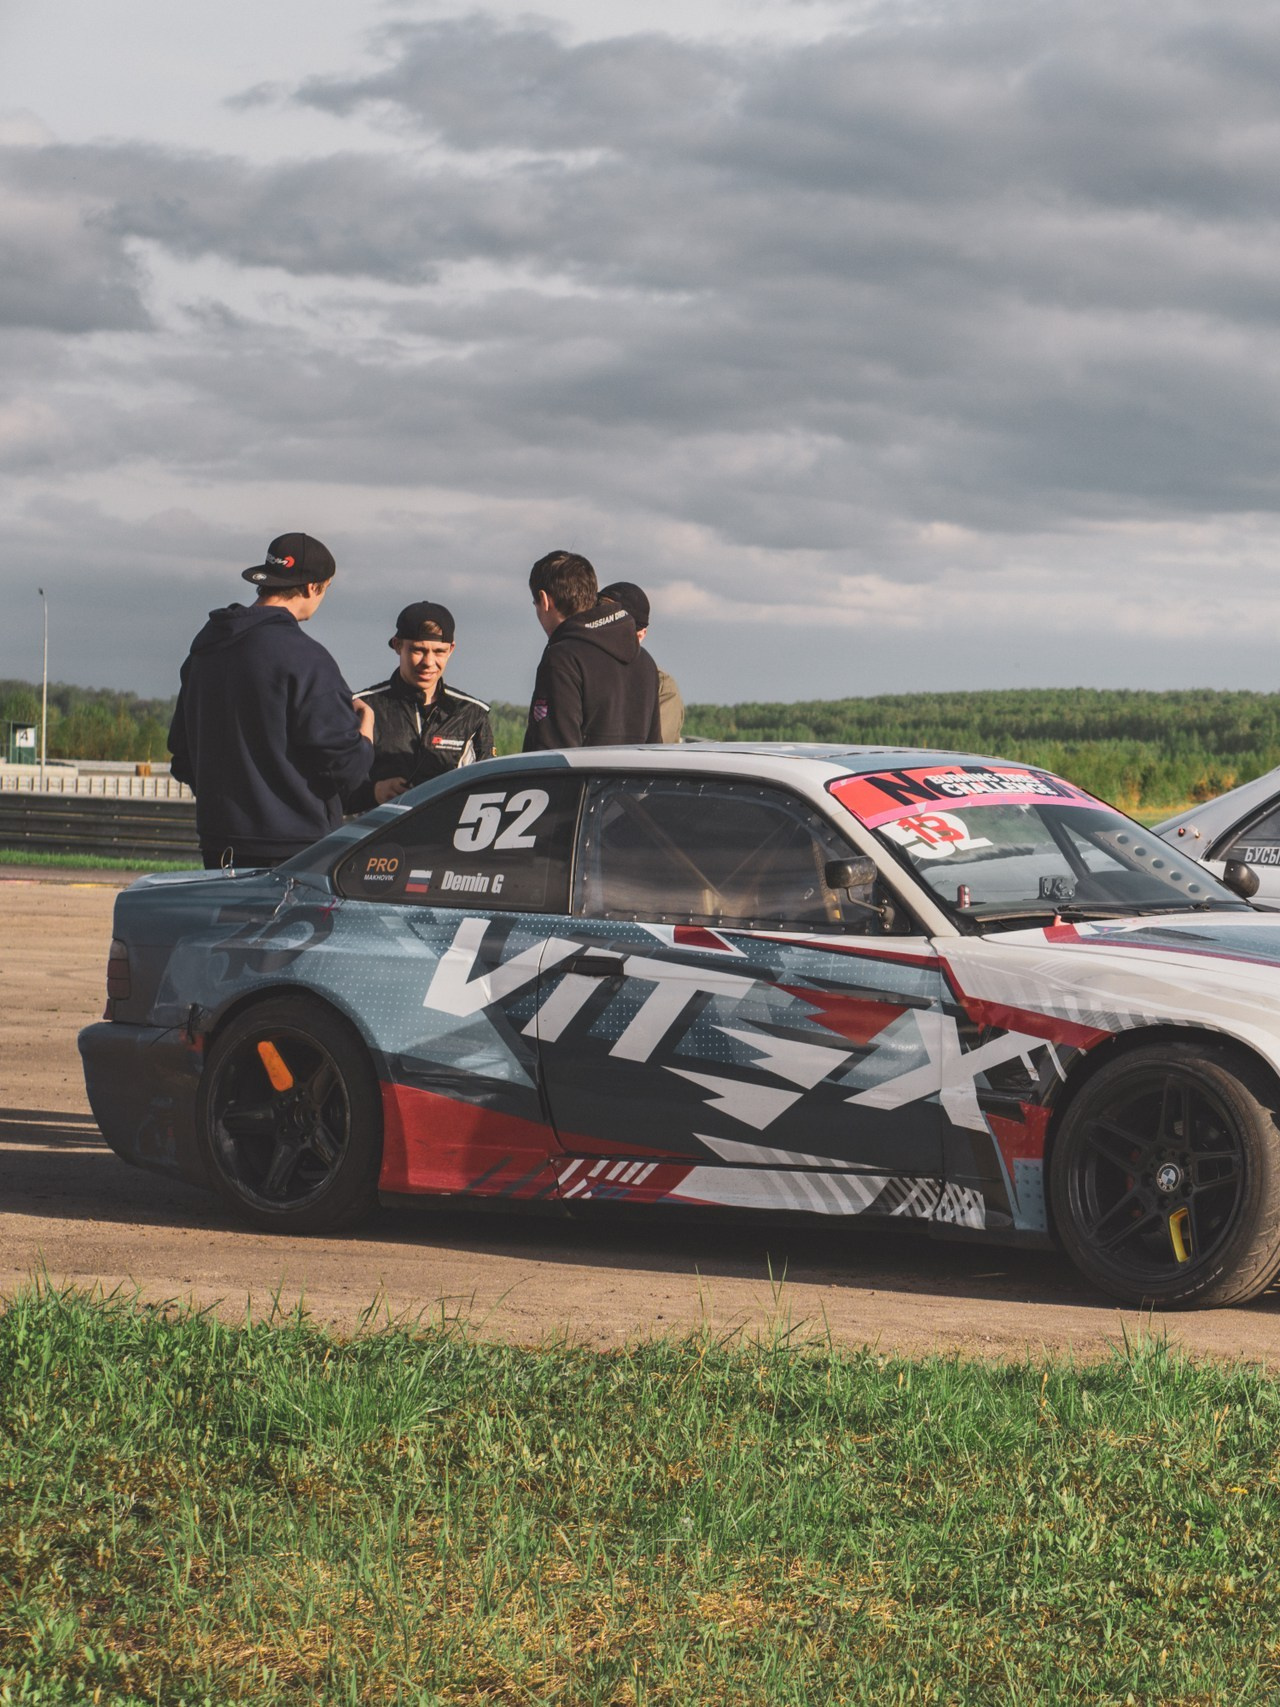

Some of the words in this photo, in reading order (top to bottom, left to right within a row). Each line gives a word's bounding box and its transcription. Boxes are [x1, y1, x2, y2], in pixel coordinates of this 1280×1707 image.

[940, 782, 1058, 796] CHALLENGE
[453, 788, 550, 852] 52
[366, 857, 399, 872] PRO
[363, 873, 395, 881] MAKHOVIK
[440, 870, 490, 893] Demin
[491, 873, 505, 894] G
